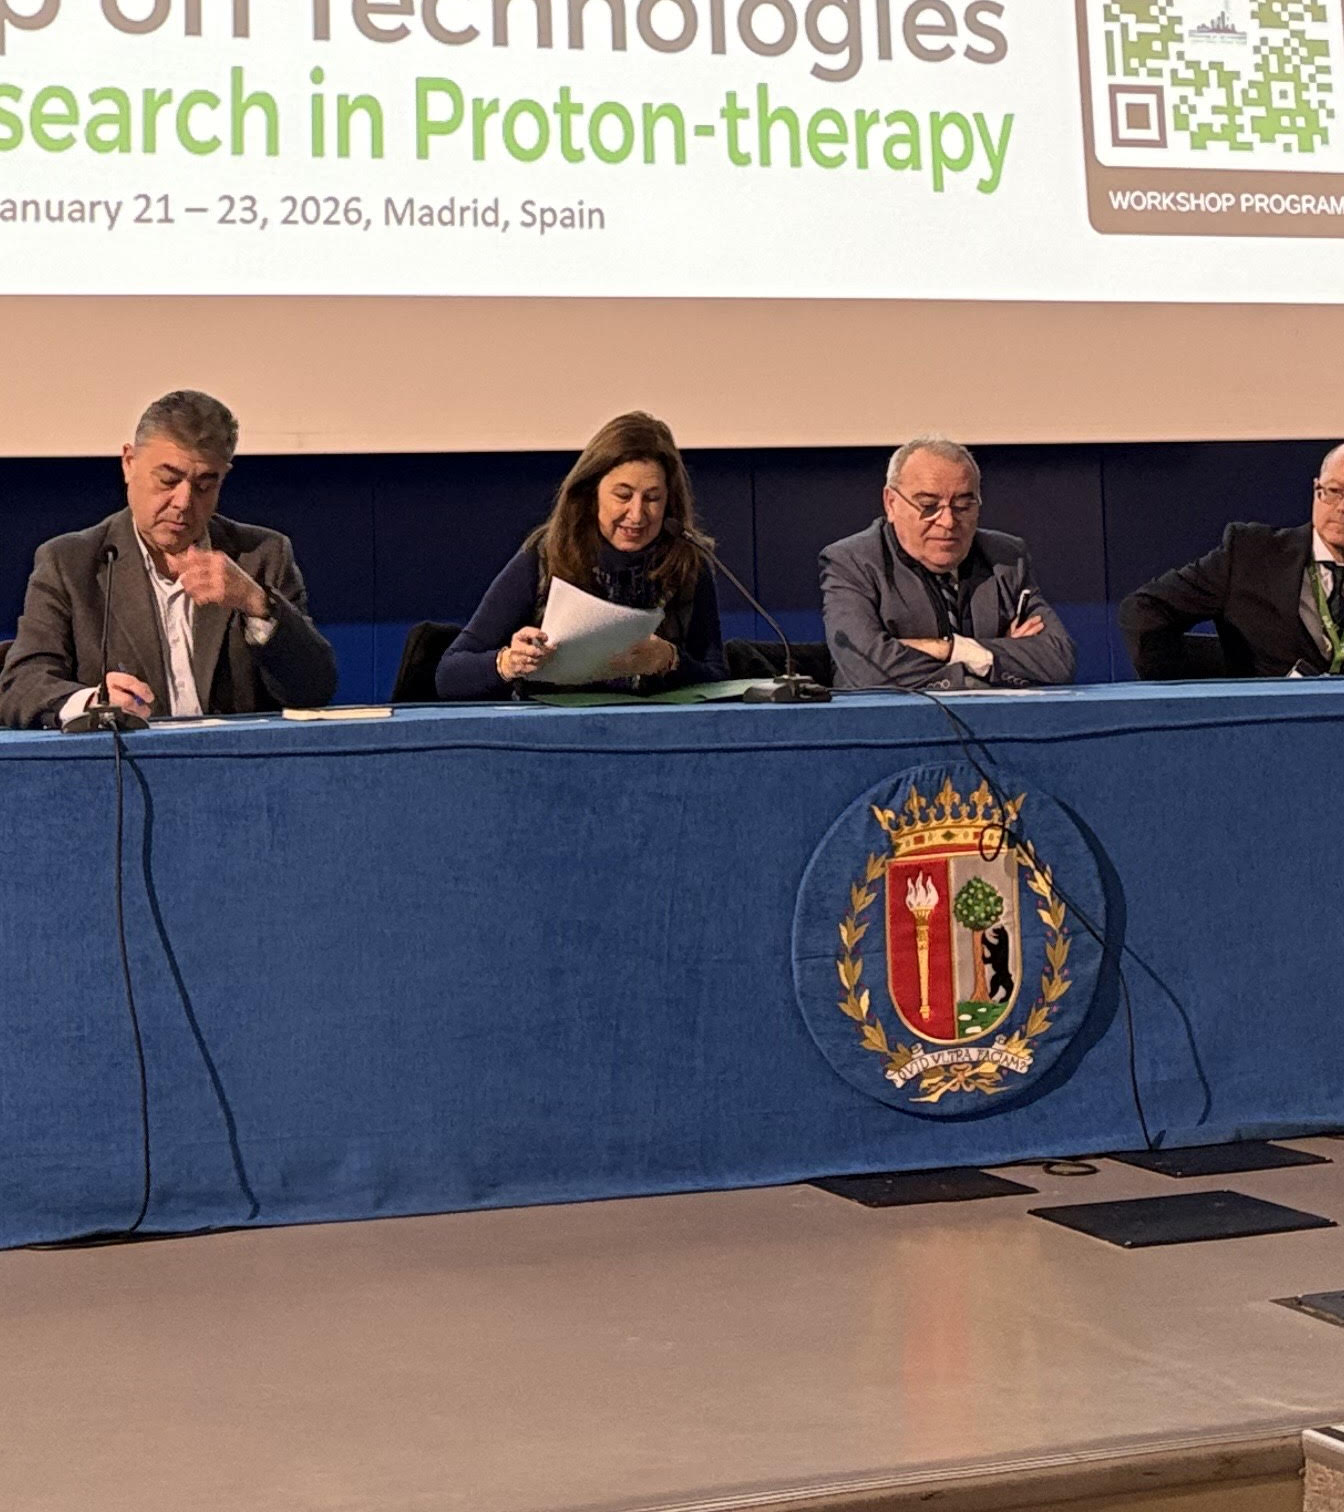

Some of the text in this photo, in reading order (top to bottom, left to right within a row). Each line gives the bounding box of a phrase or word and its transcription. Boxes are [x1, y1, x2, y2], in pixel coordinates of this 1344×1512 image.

[309, 65, 386, 159] in
[415, 75, 1015, 194] Proton-therapy
[133, 193, 176, 224] 21
[217, 194, 269, 231] 23,
[279, 195, 373, 232] 2026,
[383, 196, 511, 233] Madrid,
[519, 198, 606, 236] Spain
[1108, 190, 1236, 214] WORKSHOP
